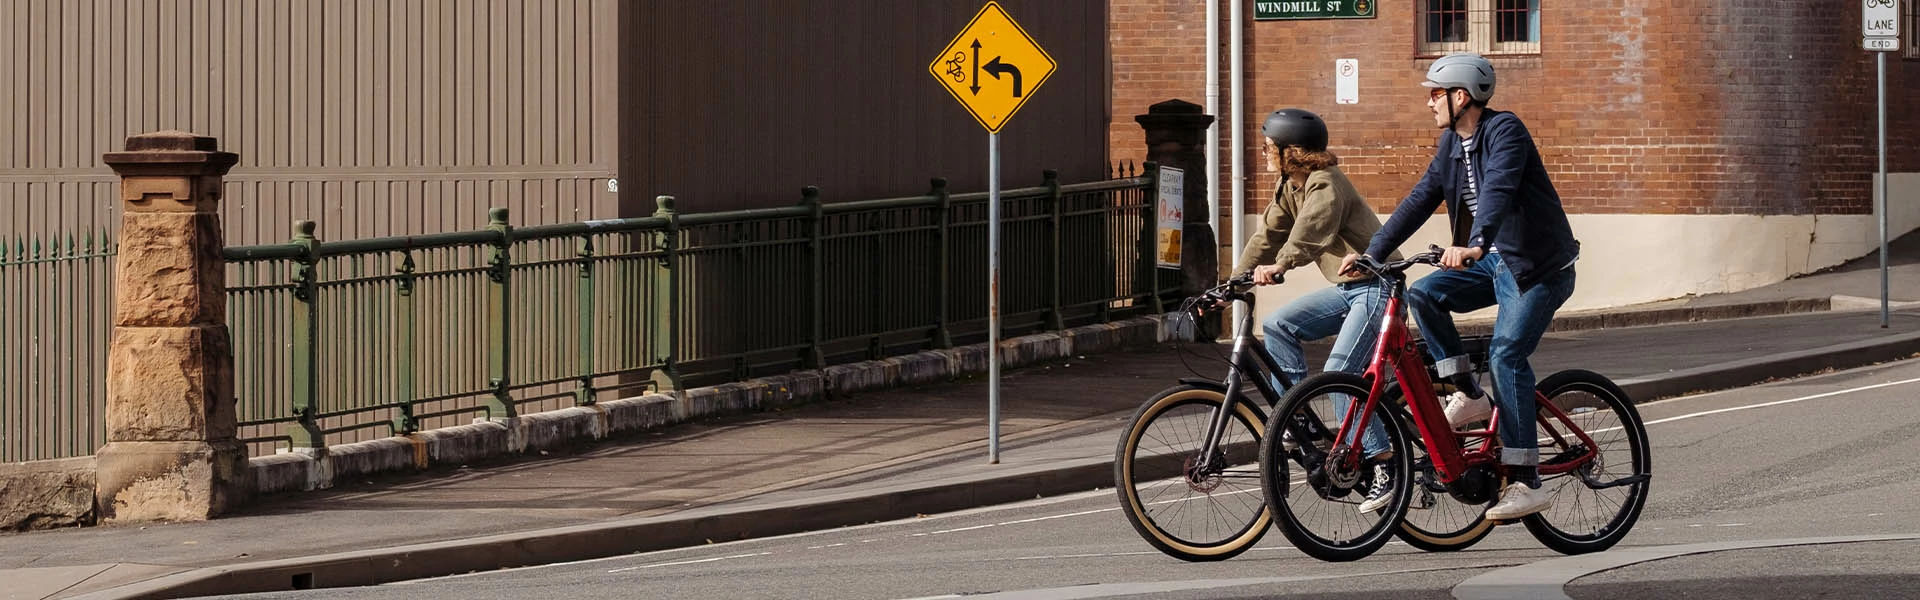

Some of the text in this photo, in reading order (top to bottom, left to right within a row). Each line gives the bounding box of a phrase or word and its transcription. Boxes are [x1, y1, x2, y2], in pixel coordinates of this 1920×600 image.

[1257, 1, 1341, 13] WINDMILL ST
[1867, 19, 1894, 30] LANE
[1871, 40, 1891, 48] END
